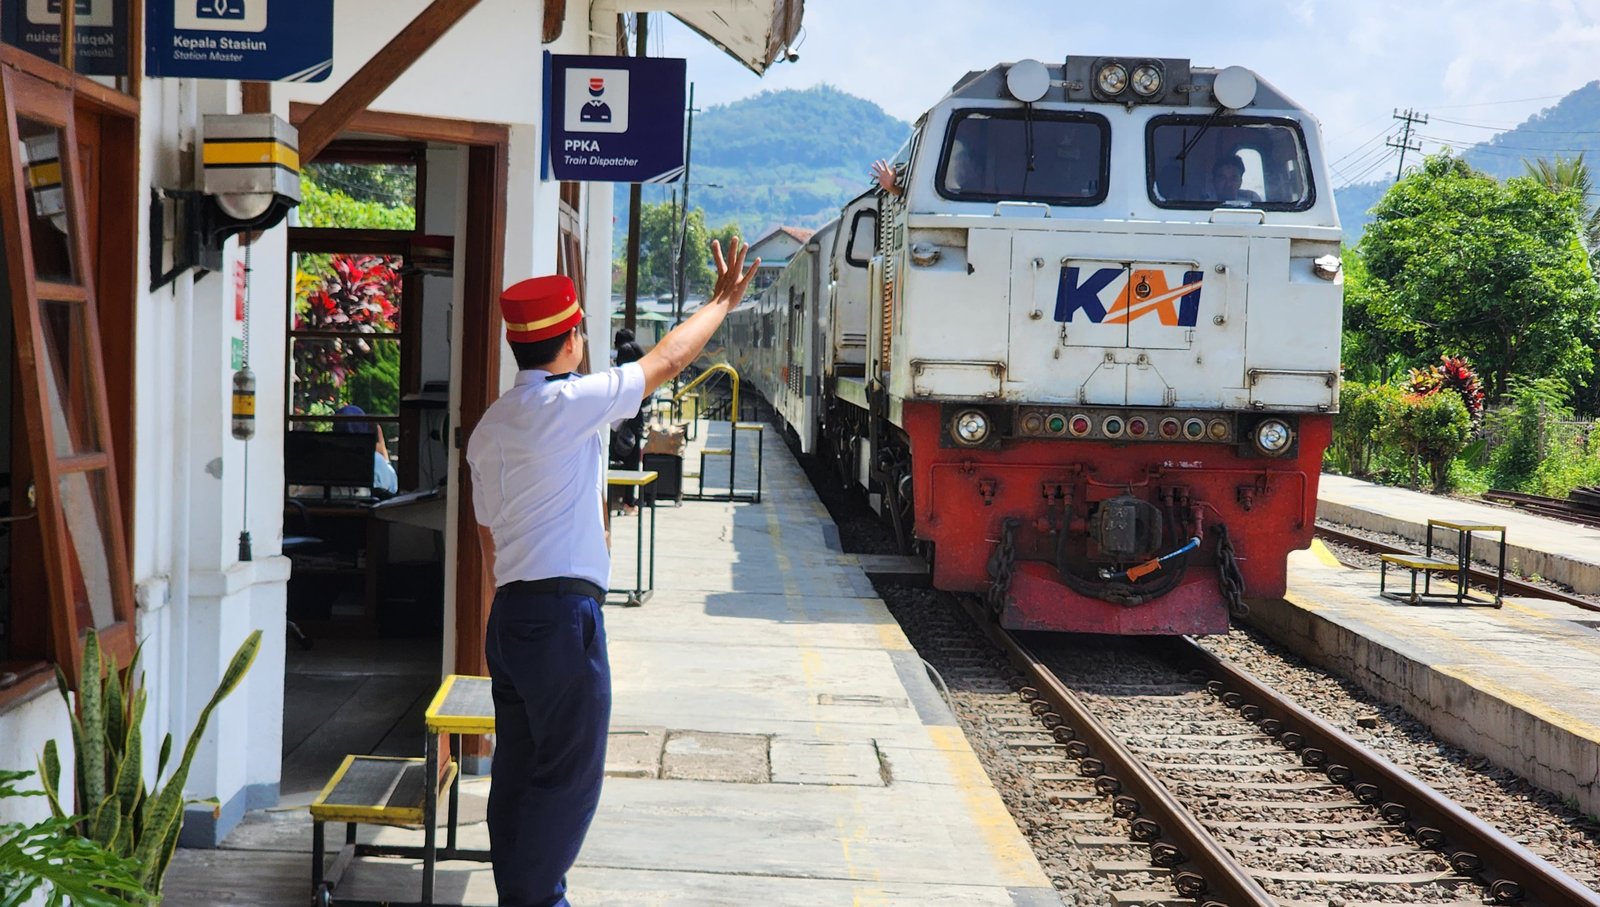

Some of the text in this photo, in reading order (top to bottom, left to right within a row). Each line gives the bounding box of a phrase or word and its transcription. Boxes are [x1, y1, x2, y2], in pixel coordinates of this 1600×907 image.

[173, 35, 267, 51] Kepala Stasiun
[173, 50, 244, 62] Station Master
[564, 139, 601, 152] PPKA
[564, 155, 639, 167] Train Dispatcher
[1054, 266, 1204, 327] KAI
